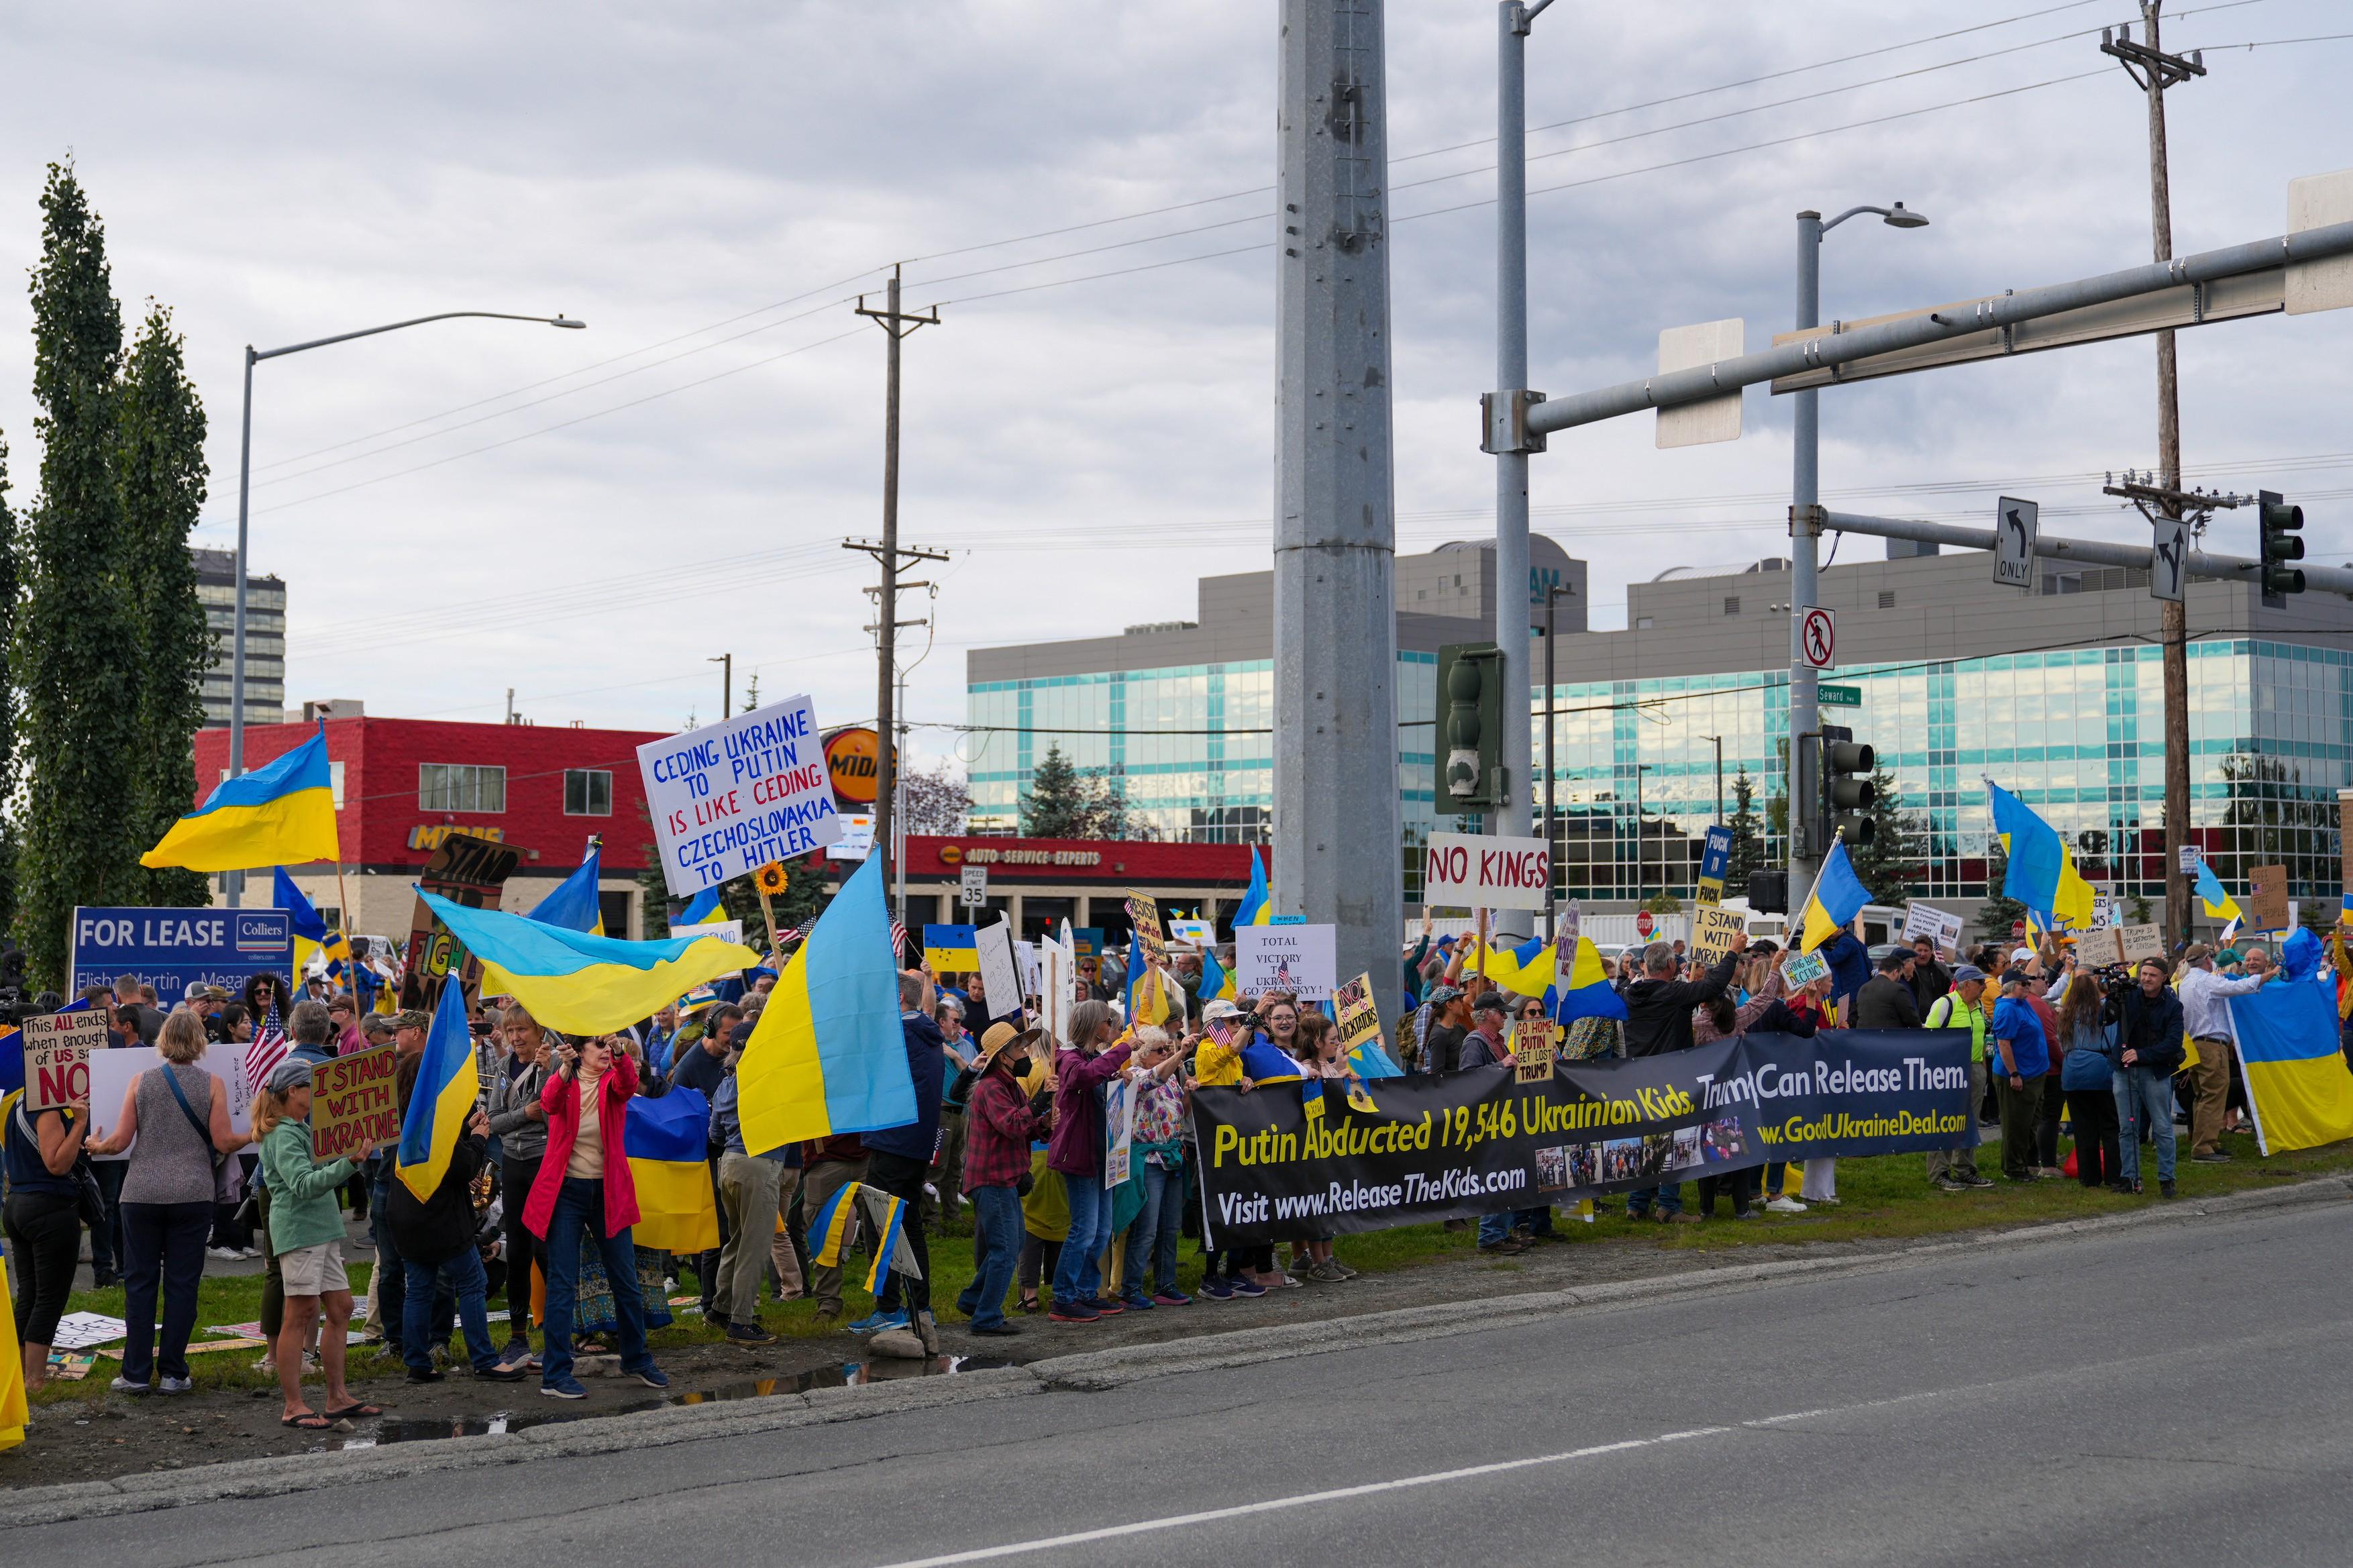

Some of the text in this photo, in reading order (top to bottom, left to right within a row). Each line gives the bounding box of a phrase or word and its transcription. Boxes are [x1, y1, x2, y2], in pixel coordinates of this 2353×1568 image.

[1999, 560, 2028, 580] ONLY
[1819, 688, 1854, 703] Seward Hwy
[653, 709, 808, 783] CEDING UKRAINE
[683, 741, 797, 798] TO PUTIN
[669, 764, 822, 836] IS LIKE CEDING
[678, 796, 835, 868] CZECHOSLOVAKIA
[1708, 834, 1729, 852] FUCK
[441, 837, 519, 883] STAND
[695, 861, 723, 885] TO
[742, 827, 817, 869] HITLER
[967, 848, 1101, 866] AUTO SERVICE EXPERTS
[1428, 846, 1548, 889] NO KINGS
[964, 888, 983, 902] 35
[1699, 886, 1720, 903] FUCK
[1127, 896, 1155, 921] RESIST
[1912, 905, 1942, 917] International
[1920, 913, 1940, 923] Criminals
[242, 922, 282, 936] Colliers
[1638, 919, 1652, 929] STOP
[1696, 909, 1744, 931] I STAND
[80, 919, 225, 947] FOR LEASE
[1261, 937, 1298, 946] TOTAL
[2013, 927, 2025, 937] STOP
[980, 935, 1006, 962] Remember
[1256, 953, 1302, 963] VICTORY
[1690, 946, 1726, 965] UKRAI
[988, 959, 1006, 986] 1938
[1782, 951, 1822, 974] BRING BACK
[1256, 976, 1302, 986] UKRANE
[1789, 962, 1826, 986] DECENCY
[403, 973, 476, 1013] BAK
[1244, 987, 1259, 996] GO
[1339, 980, 1361, 1008] NO
[1342, 1007, 1351, 1021] NO
[1358, 1000, 1368, 1011] NO
[23, 1018, 52, 1033] This
[75, 1012, 107, 1028] ends
[1339, 1007, 1378, 1043] DICKTATORS
[1516, 1020, 1553, 1035] GO HOME
[24, 1029, 107, 1051] when enough
[1521, 1034, 1546, 1051] PUTIN
[36, 1051, 50, 1065] of
[54, 1049, 74, 1063] US
[1518, 1049, 1552, 1063] GET LOST
[314, 1051, 397, 1097] I STAND
[1520, 1062, 1547, 1080] TRUMP
[38, 1062, 89, 1106] NO
[327, 1085, 389, 1118] WITH
[1214, 1123, 1297, 1167] Putin
[1302, 1110, 1432, 1161] Abducted
[1441, 1098, 1516, 1152] 19,546
[1523, 1091, 1641, 1136] Ukrainian
[1636, 1084, 1695, 1122] Kids.
[1757, 1063, 1810, 1099] Can
[1815, 1060, 1901, 1094] Release
[1903, 1057, 1968, 1092] Them.
[313, 1108, 401, 1157] UKRAINE
[1218, 1165, 1526, 1226] Visit www.ReleaseTheKids.com
